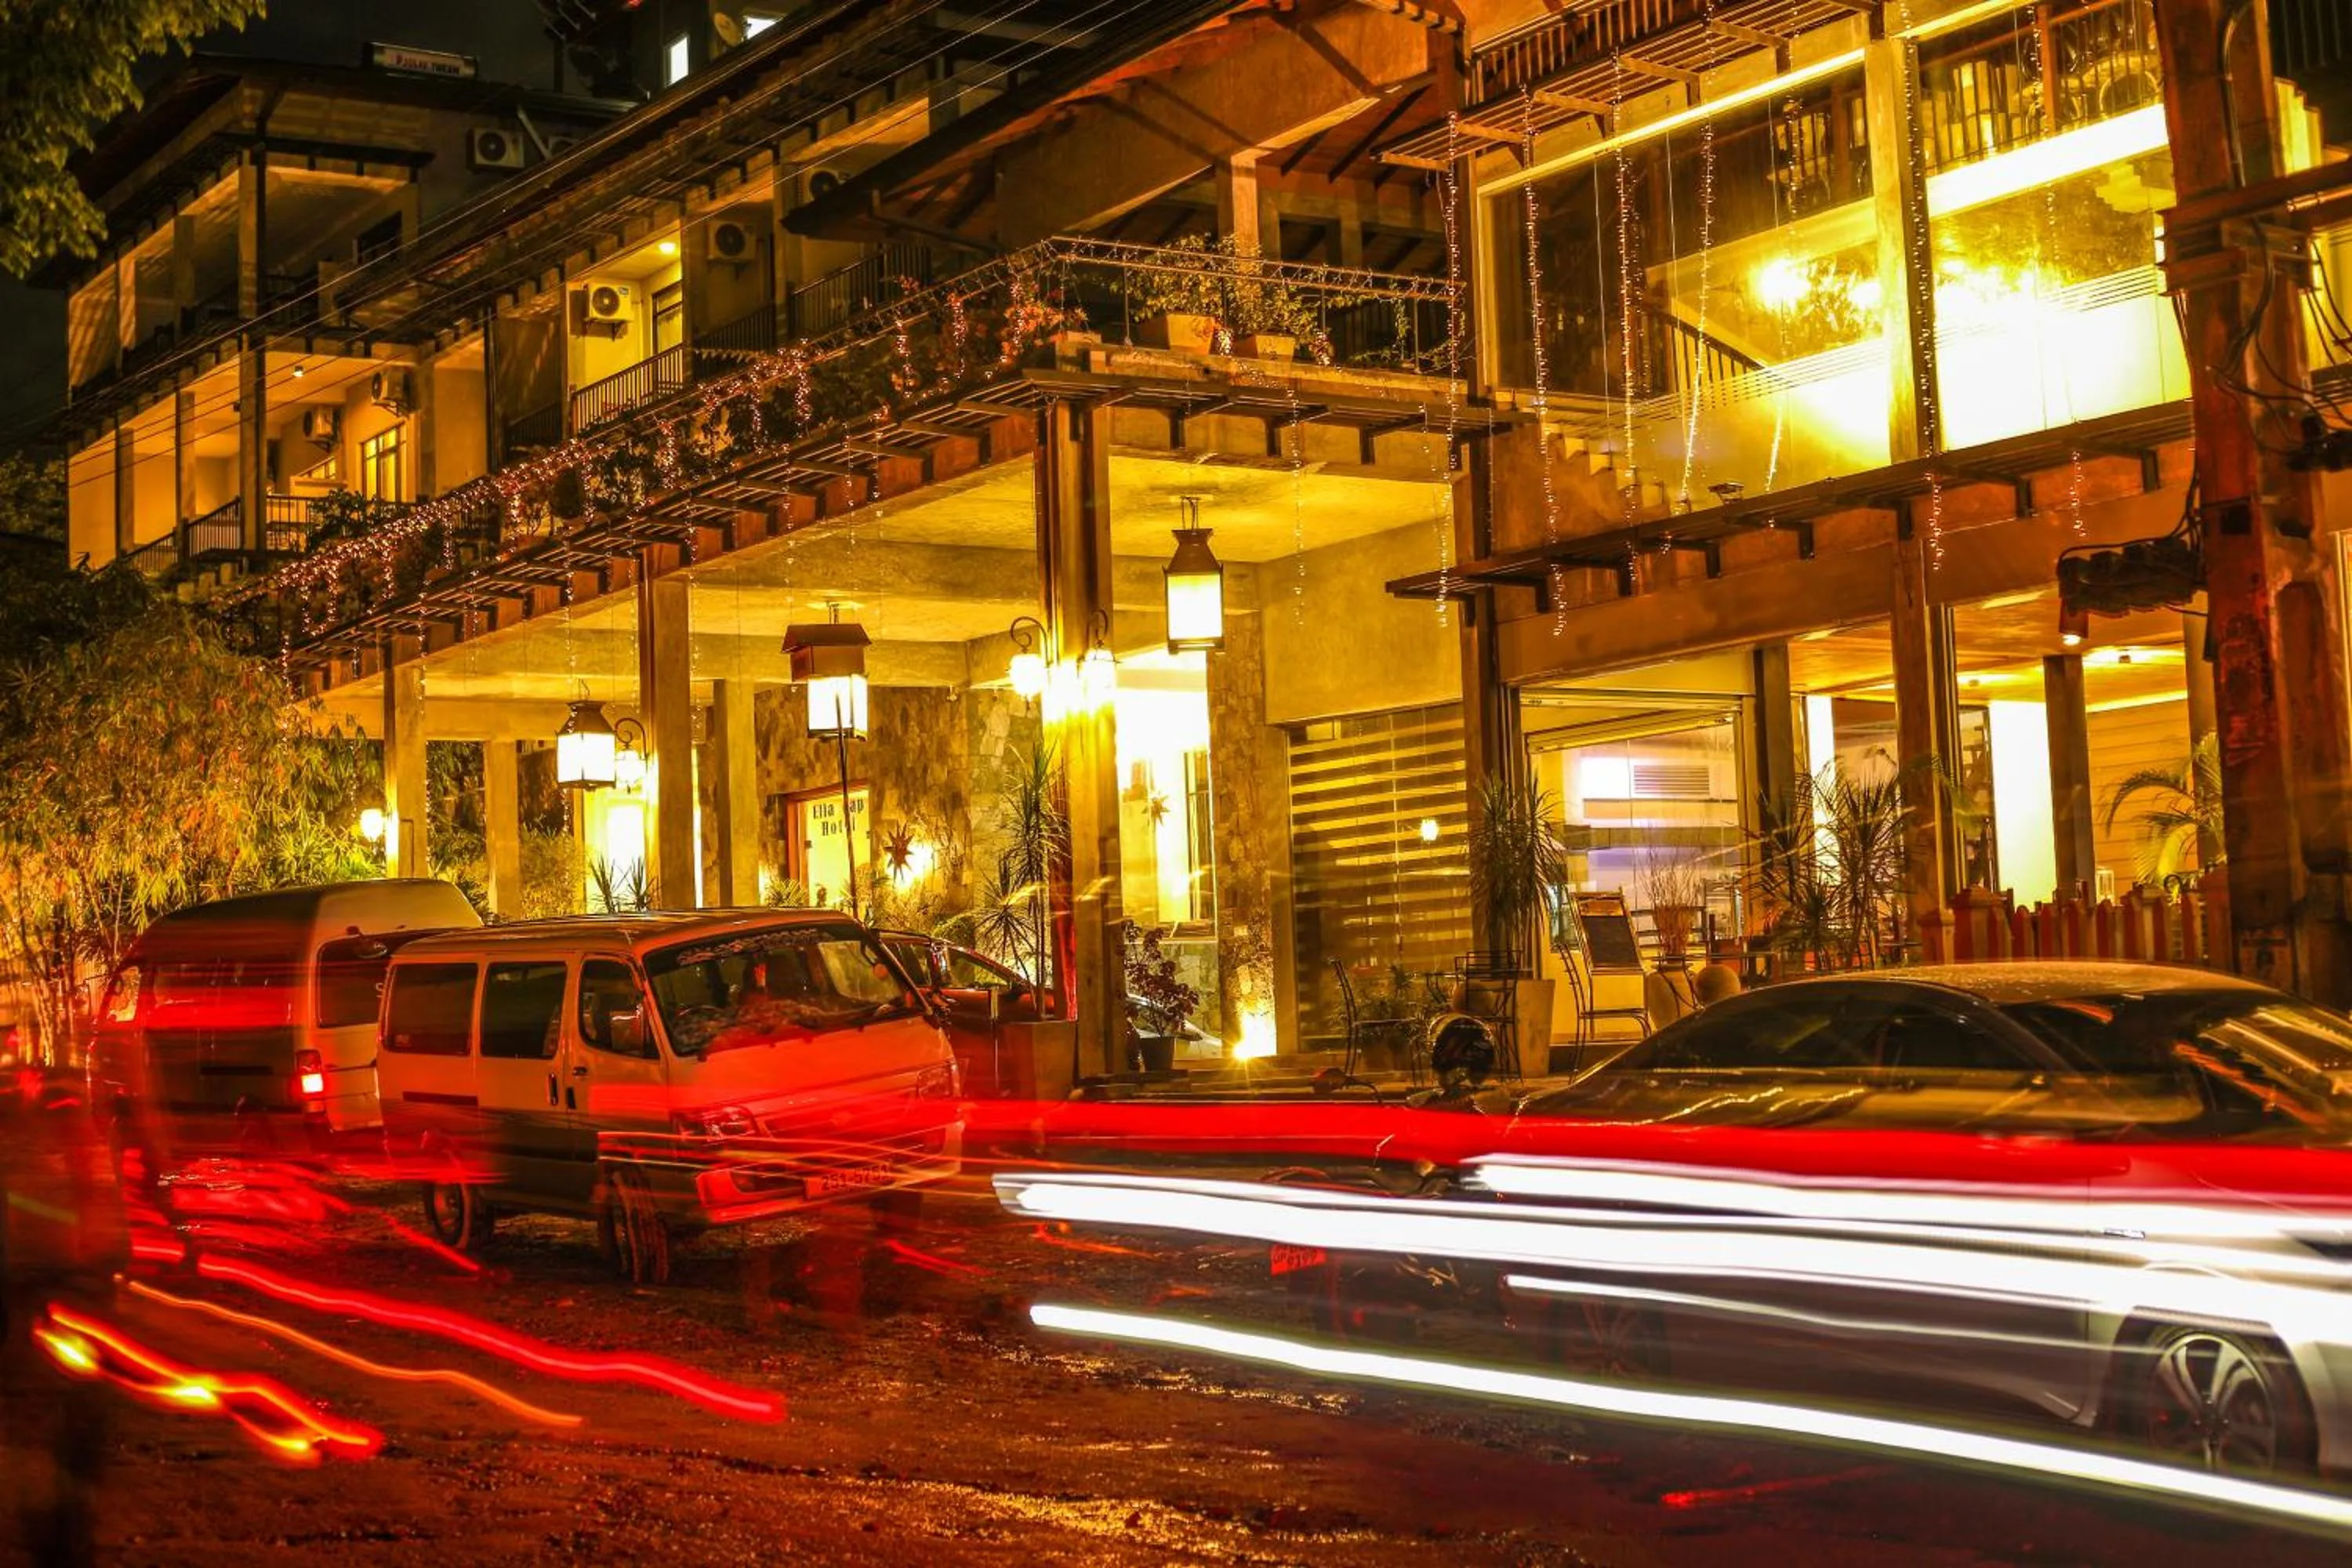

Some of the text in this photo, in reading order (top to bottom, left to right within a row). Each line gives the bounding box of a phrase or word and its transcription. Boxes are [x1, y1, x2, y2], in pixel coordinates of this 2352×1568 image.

[813, 798, 864, 819] Ella ap
[822, 815, 856, 837] Hotl
